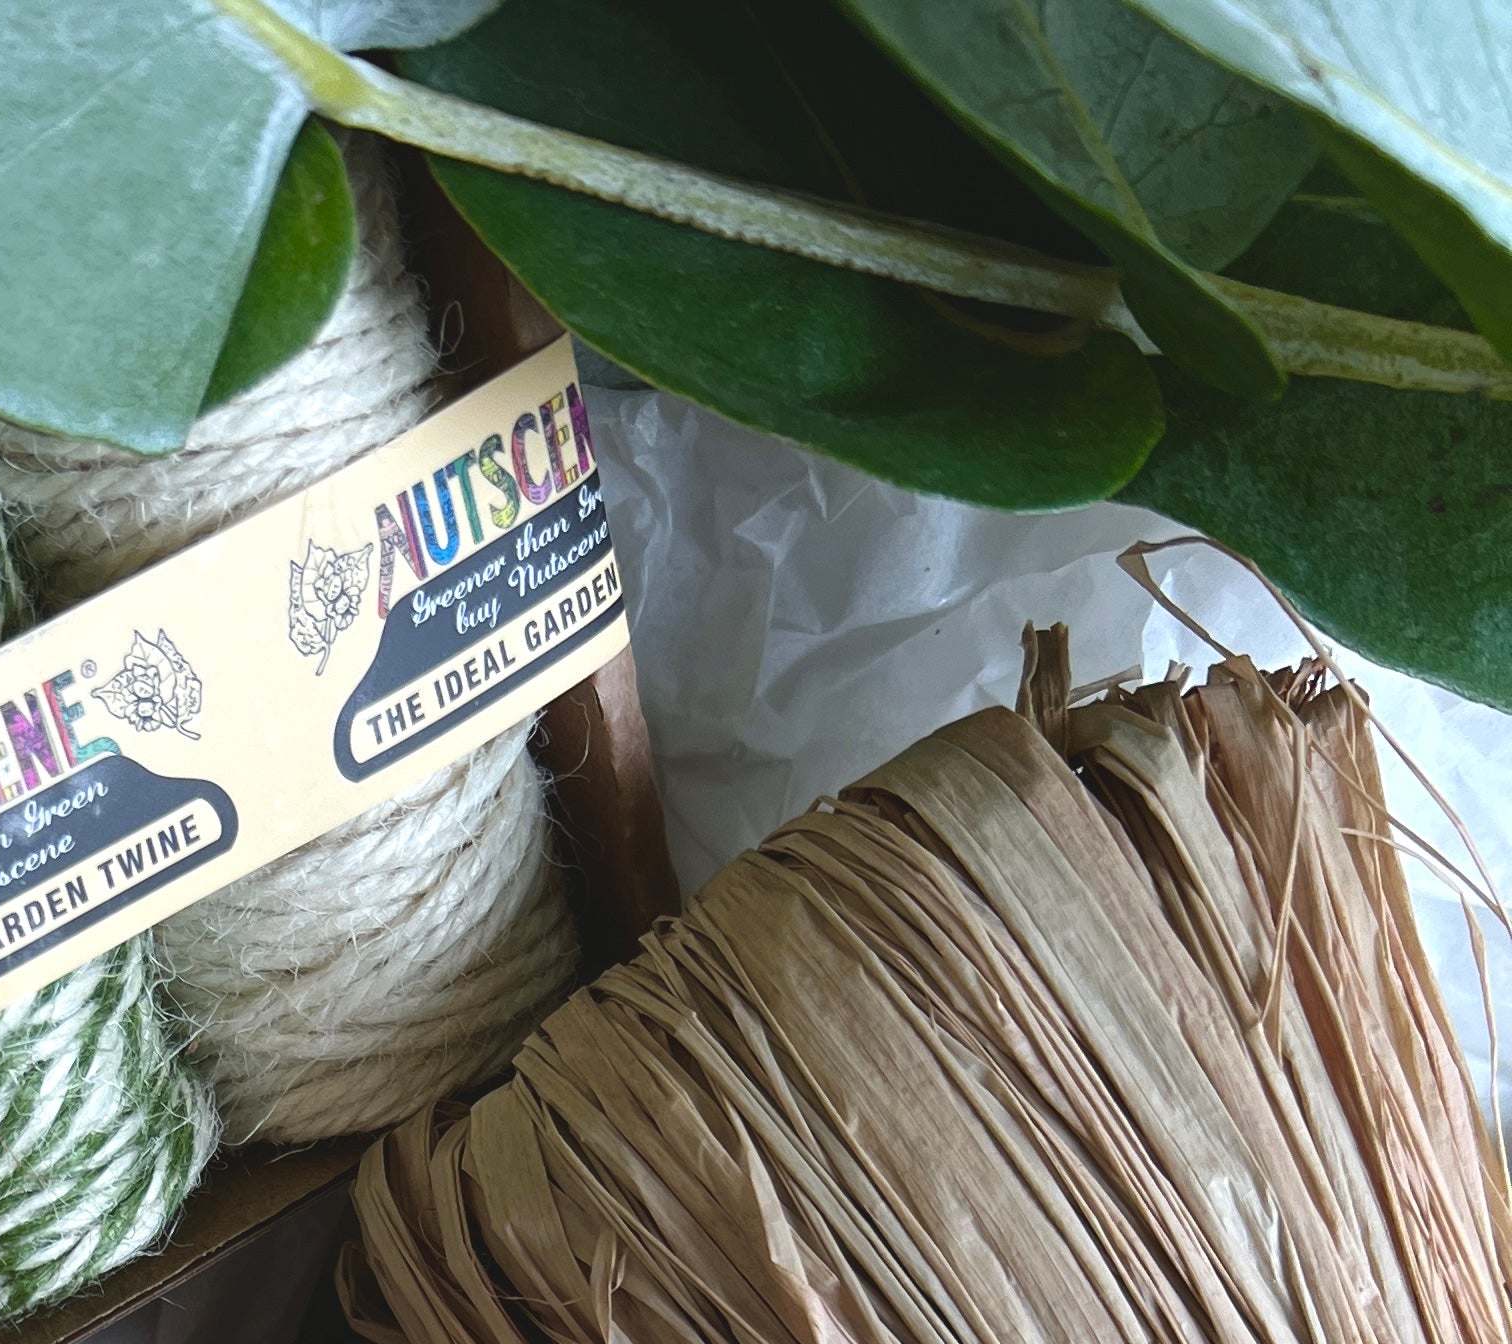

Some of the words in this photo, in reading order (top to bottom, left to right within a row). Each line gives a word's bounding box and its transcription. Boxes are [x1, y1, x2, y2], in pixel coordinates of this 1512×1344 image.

[410, 556, 507, 628] Greener
[516, 513, 571, 568] than
[456, 599, 501, 636] buy
[508, 520, 608, 599] Nutscene
[367, 692, 426, 746] THE
[434, 646, 516, 710] IDEAL
[524, 563, 619, 652] GARDEN
[23, 781, 109, 834] Green
[97, 814, 202, 891] TWINE
